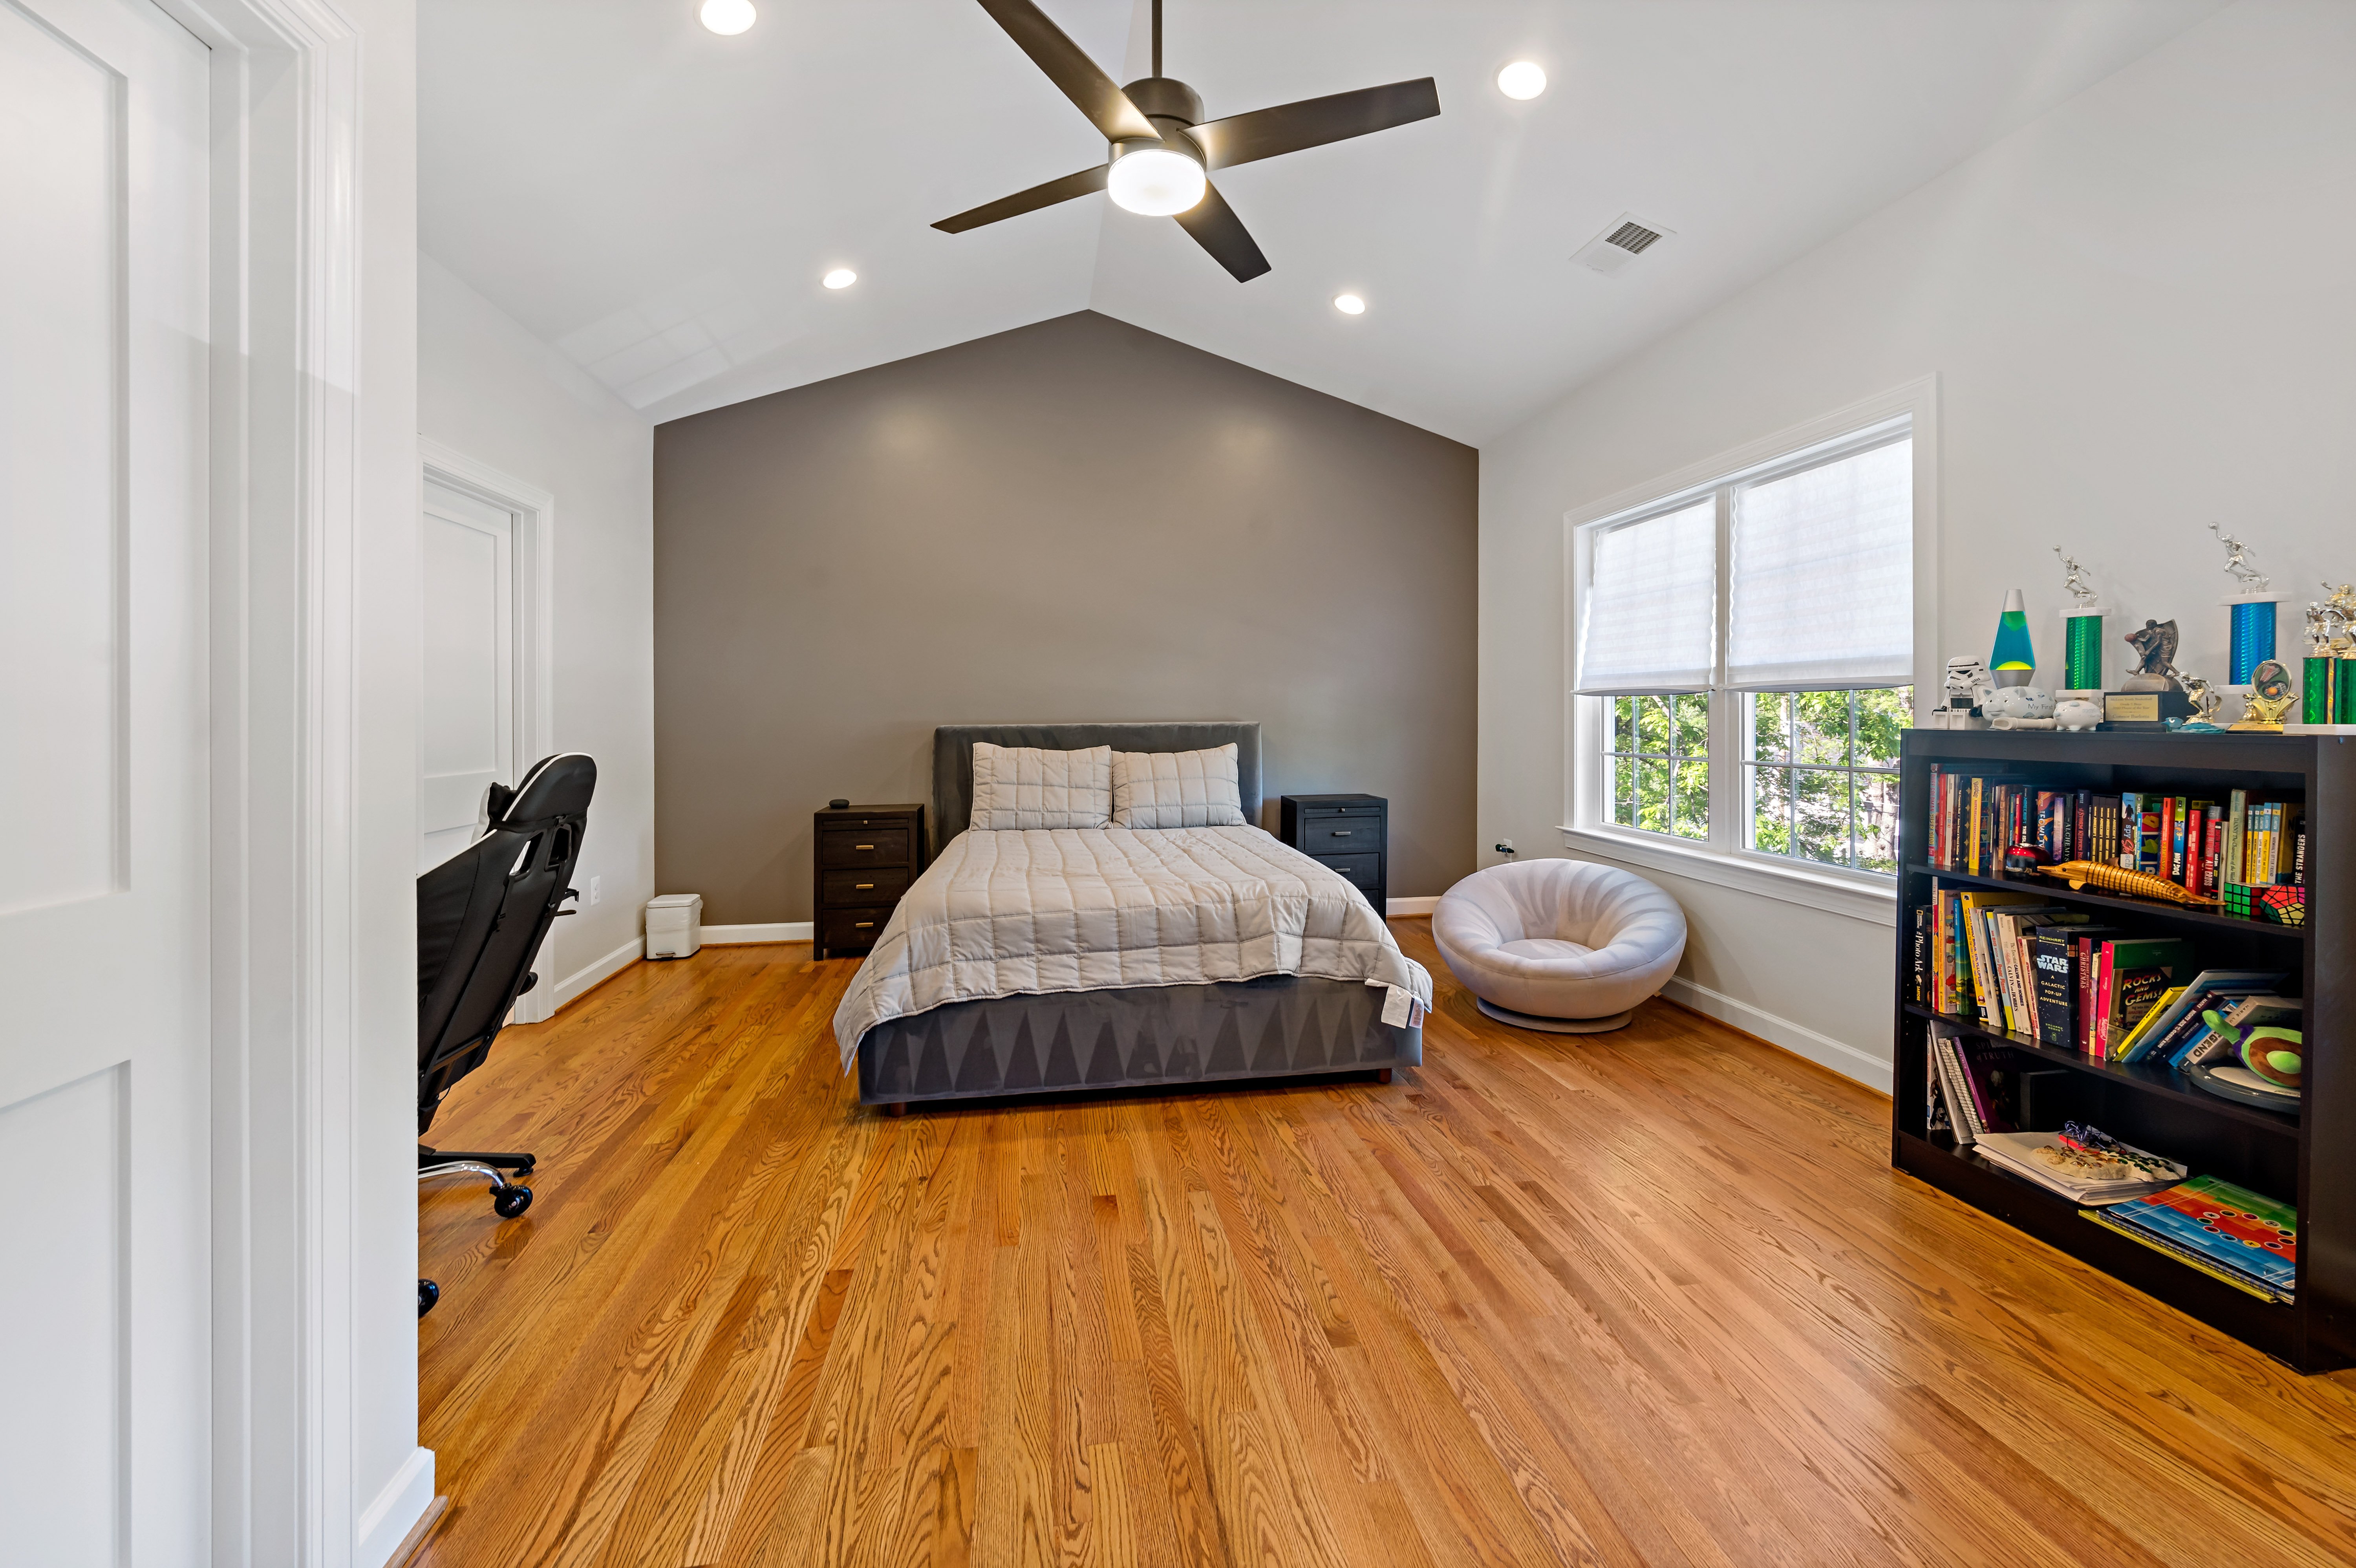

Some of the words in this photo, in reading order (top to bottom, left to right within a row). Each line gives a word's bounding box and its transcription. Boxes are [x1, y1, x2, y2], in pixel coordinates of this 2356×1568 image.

[2124, 825, 2132, 838] spy
[2296, 834, 2306, 870] STRANGERS
[2172, 864, 2180, 875] DOG
[2295, 872, 2303, 884] THE
[1915, 935, 1923, 957] Photo
[1915, 958, 1923, 972] Ark
[2037, 955, 2068, 966] STAR
[2037, 961, 2069, 973] WARS
[1974, 953, 1983, 987] ENCYCLOPEDIA
[2041, 981, 2065, 990] GALACTIC
[2122, 973, 2161, 990] ROCKS
[2040, 997, 2067, 1006] ADVENTURE
[2125, 988, 2162, 1006] GEMS!
[2235, 1004, 2250, 1018] MARIE
[1983, 1050, 2014, 1060] TRUTH
